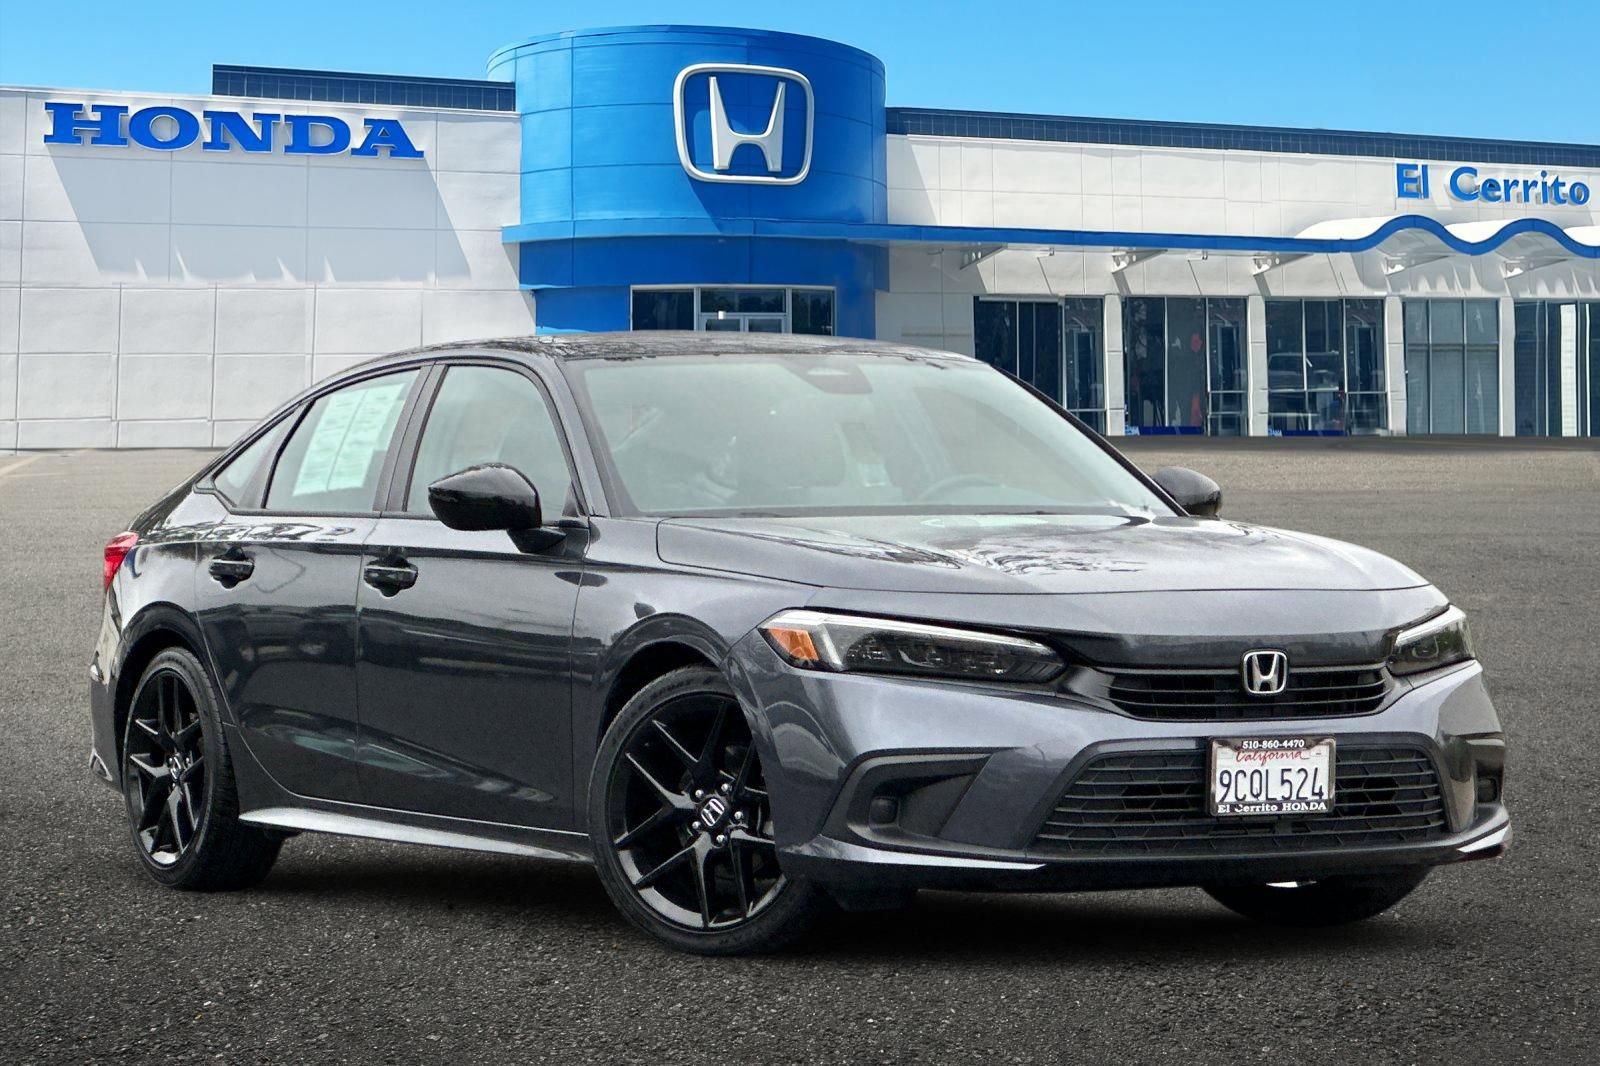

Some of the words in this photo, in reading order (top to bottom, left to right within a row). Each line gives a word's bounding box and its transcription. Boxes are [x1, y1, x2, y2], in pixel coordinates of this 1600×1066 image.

[44, 101, 425, 159] HONDA
[1395, 162, 1430, 199] El
[1449, 166, 1591, 206] Cerrito
[1242, 740, 1305, 749] 510-860-4470
[1219, 767, 1324, 803] 9CQL524
[1217, 804, 1231, 814] El
[1282, 802, 1327, 811] HONDA
